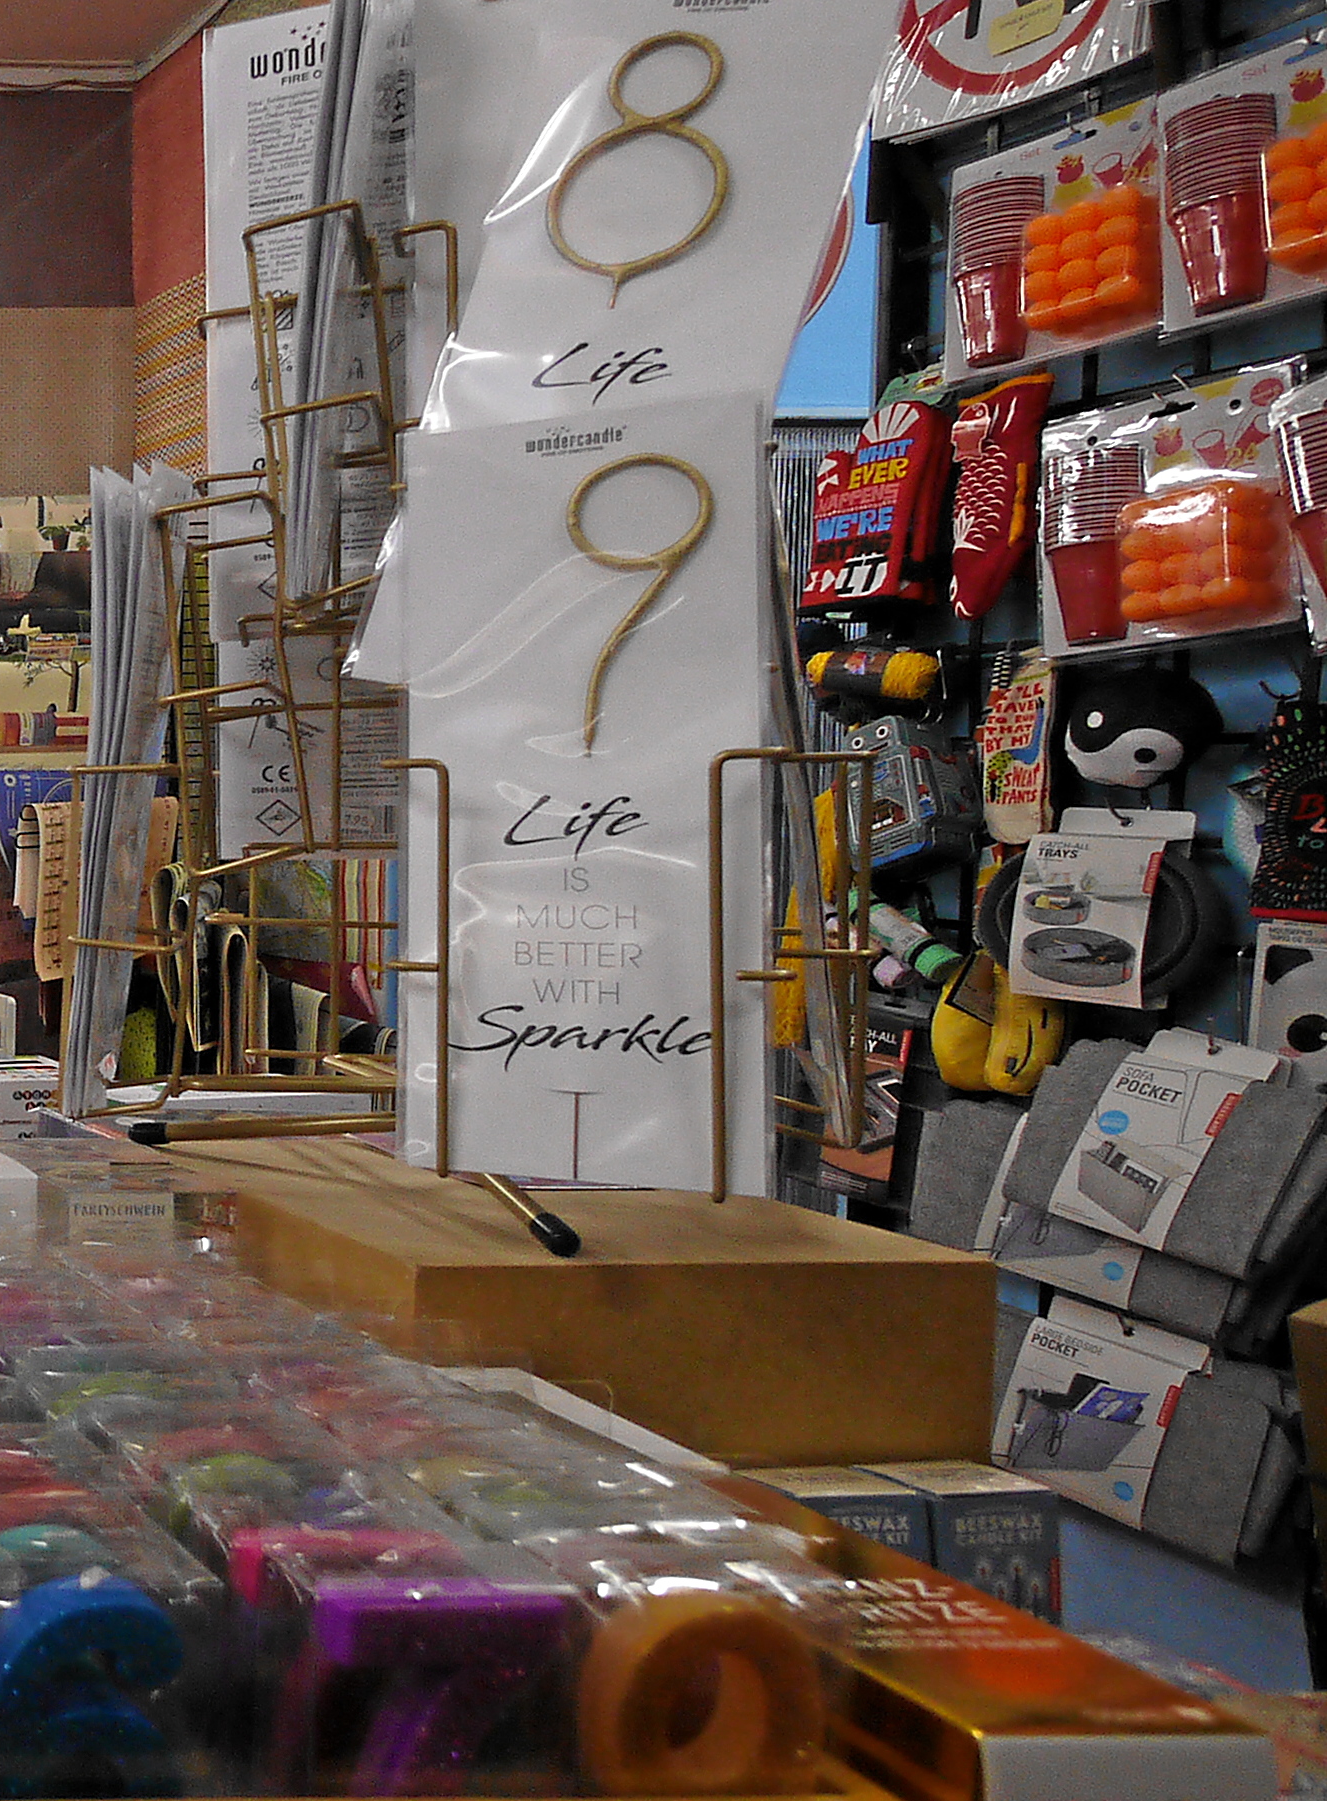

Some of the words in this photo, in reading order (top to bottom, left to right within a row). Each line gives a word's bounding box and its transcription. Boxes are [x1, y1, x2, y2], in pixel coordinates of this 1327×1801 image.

[281, 72, 309, 86] FIRE
[532, 342, 673, 406] Life
[525, 427, 623, 453] wondercandle
[858, 438, 913, 465] WHAT
[848, 458, 909, 490] EVER
[816, 506, 894, 542] WE'RE
[835, 555, 888, 595] IT
[985, 724, 1032, 735] THAT
[986, 737, 1003, 753] BY
[1011, 733, 1030, 748] MY
[1004, 763, 1040, 787] SWEAT
[1002, 789, 1038, 805] PANTS
[504, 795, 649, 860] Life
[1037, 848, 1078, 859] TRAYS
[563, 867, 589, 893] IS
[516, 904, 637, 930] MUCH
[514, 941, 643, 969] BETTER
[533, 979, 621, 1005] WITH
[449, 1005, 713, 1072] Sparkle
[1123, 1066, 1154, 1081] SOFA
[1115, 1076, 1183, 1103] POCKET
[1031, 1333, 1080, 1359] POCKET
[955, 1514, 1043, 1532] BEESWAX
